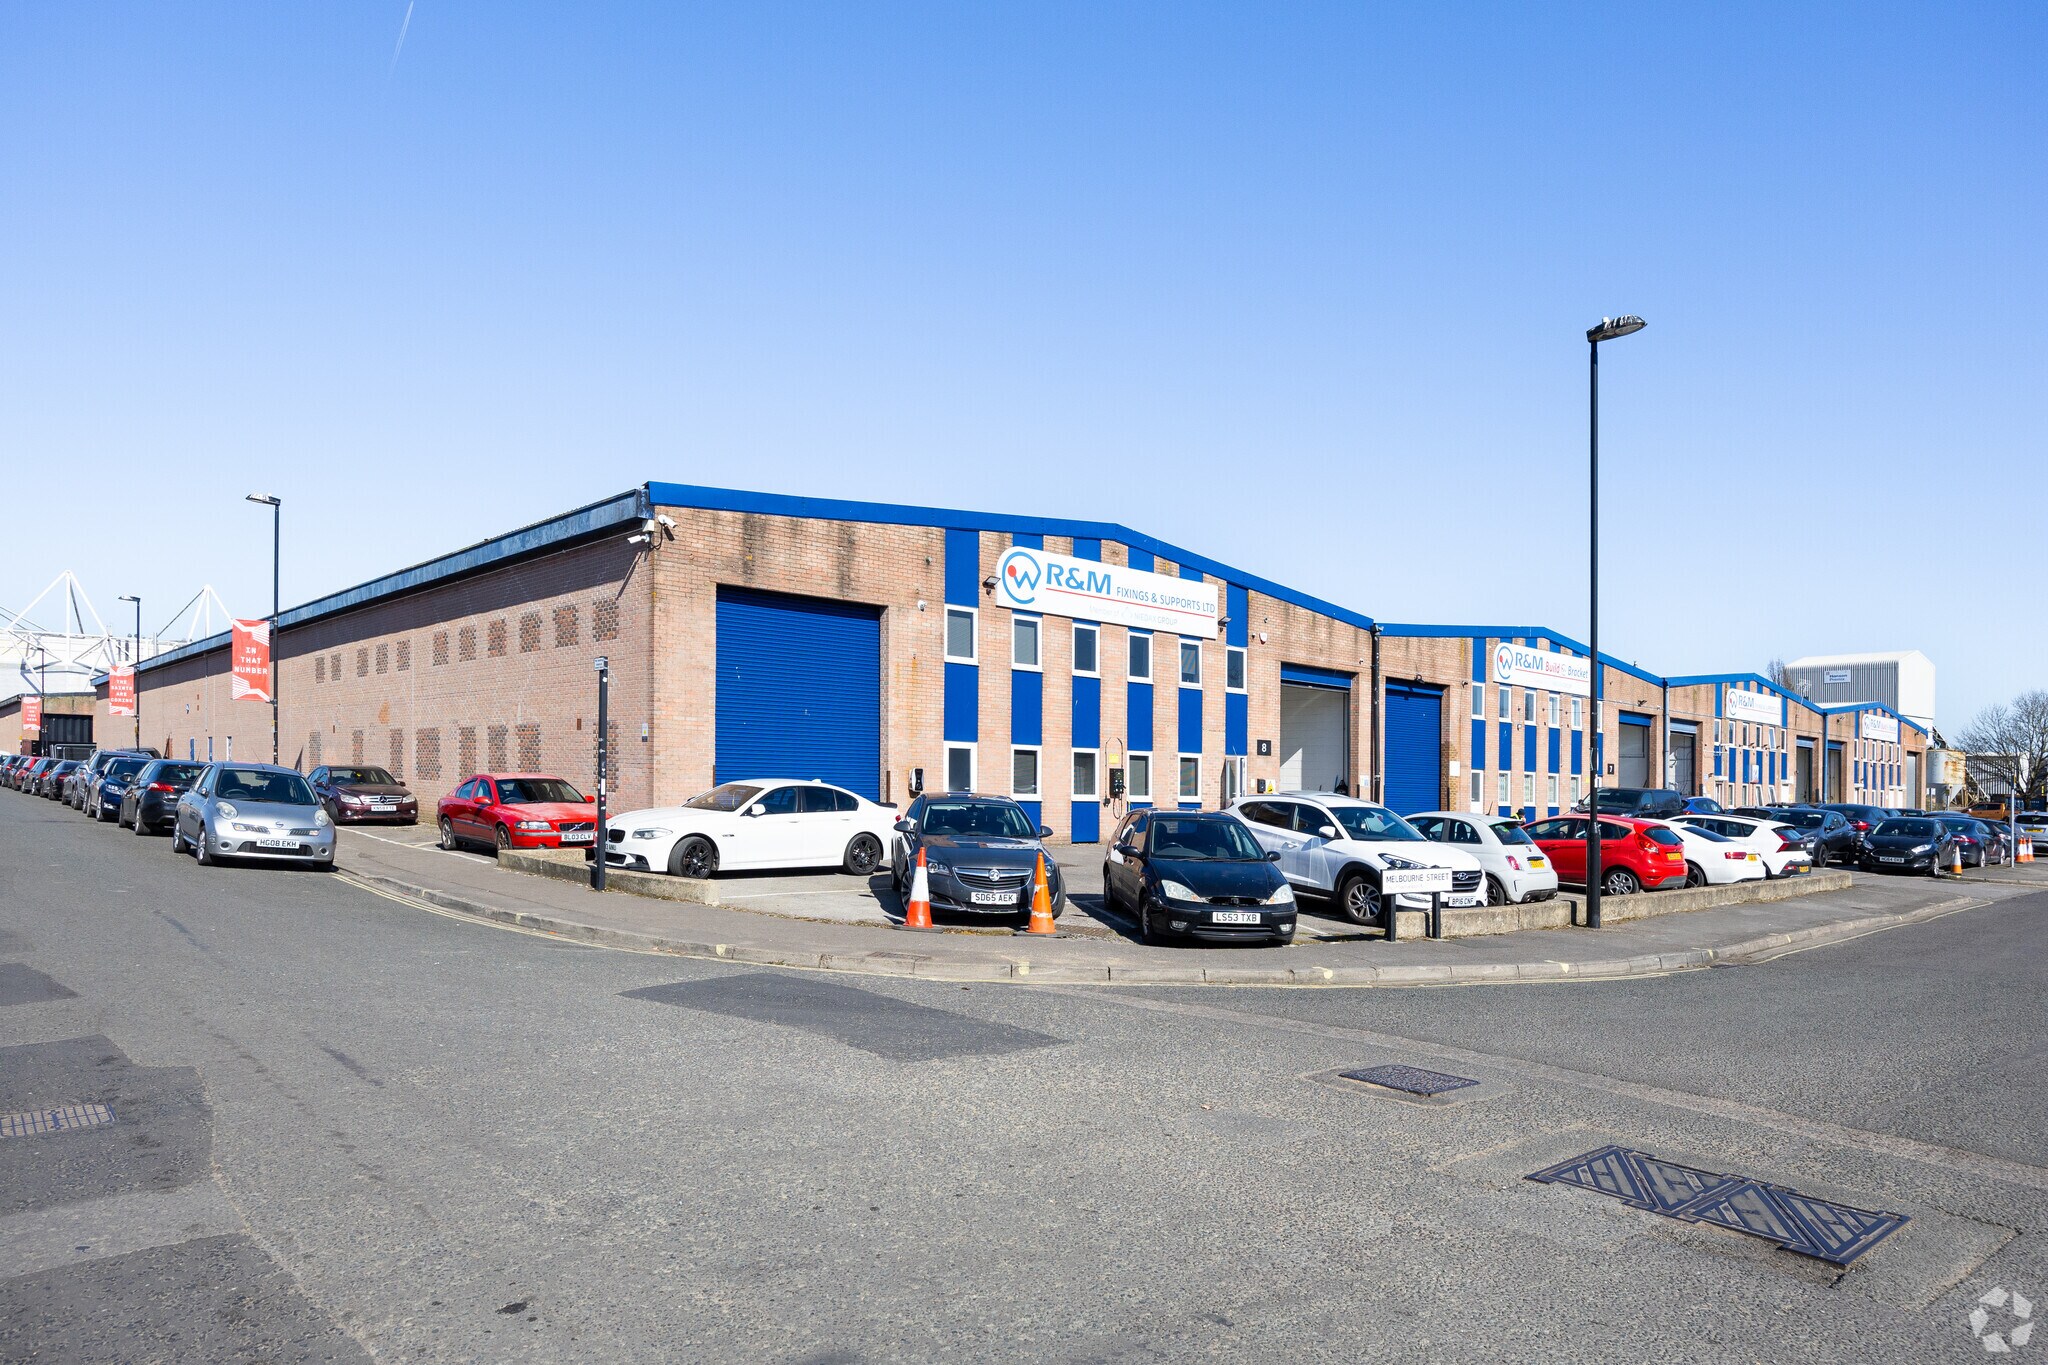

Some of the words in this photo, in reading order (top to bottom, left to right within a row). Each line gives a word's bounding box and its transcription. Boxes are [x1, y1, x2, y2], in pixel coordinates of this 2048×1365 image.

[1046, 563, 1111, 595] R&M
[1116, 586, 1149, 601] FIXINGS
[1151, 593, 1158, 603] &
[1160, 594, 1201, 610] SUPPORTS
[1202, 602, 1216, 613] LTD
[1157, 615, 1178, 626] GROUP
[241, 656, 261, 664] THAT
[1515, 652, 1543, 670] R&M
[234, 666, 268, 675] NUMBER
[1262, 743, 1267, 752] 8
[259, 839, 280, 847] HG08
[1385, 873, 1424, 883] MELBOURNE
[1426, 872, 1449, 881] STREET
[998, 894, 1014, 902] AEK
[1216, 913, 1239, 921] LS53
[1241, 913, 1257, 922] TXB
